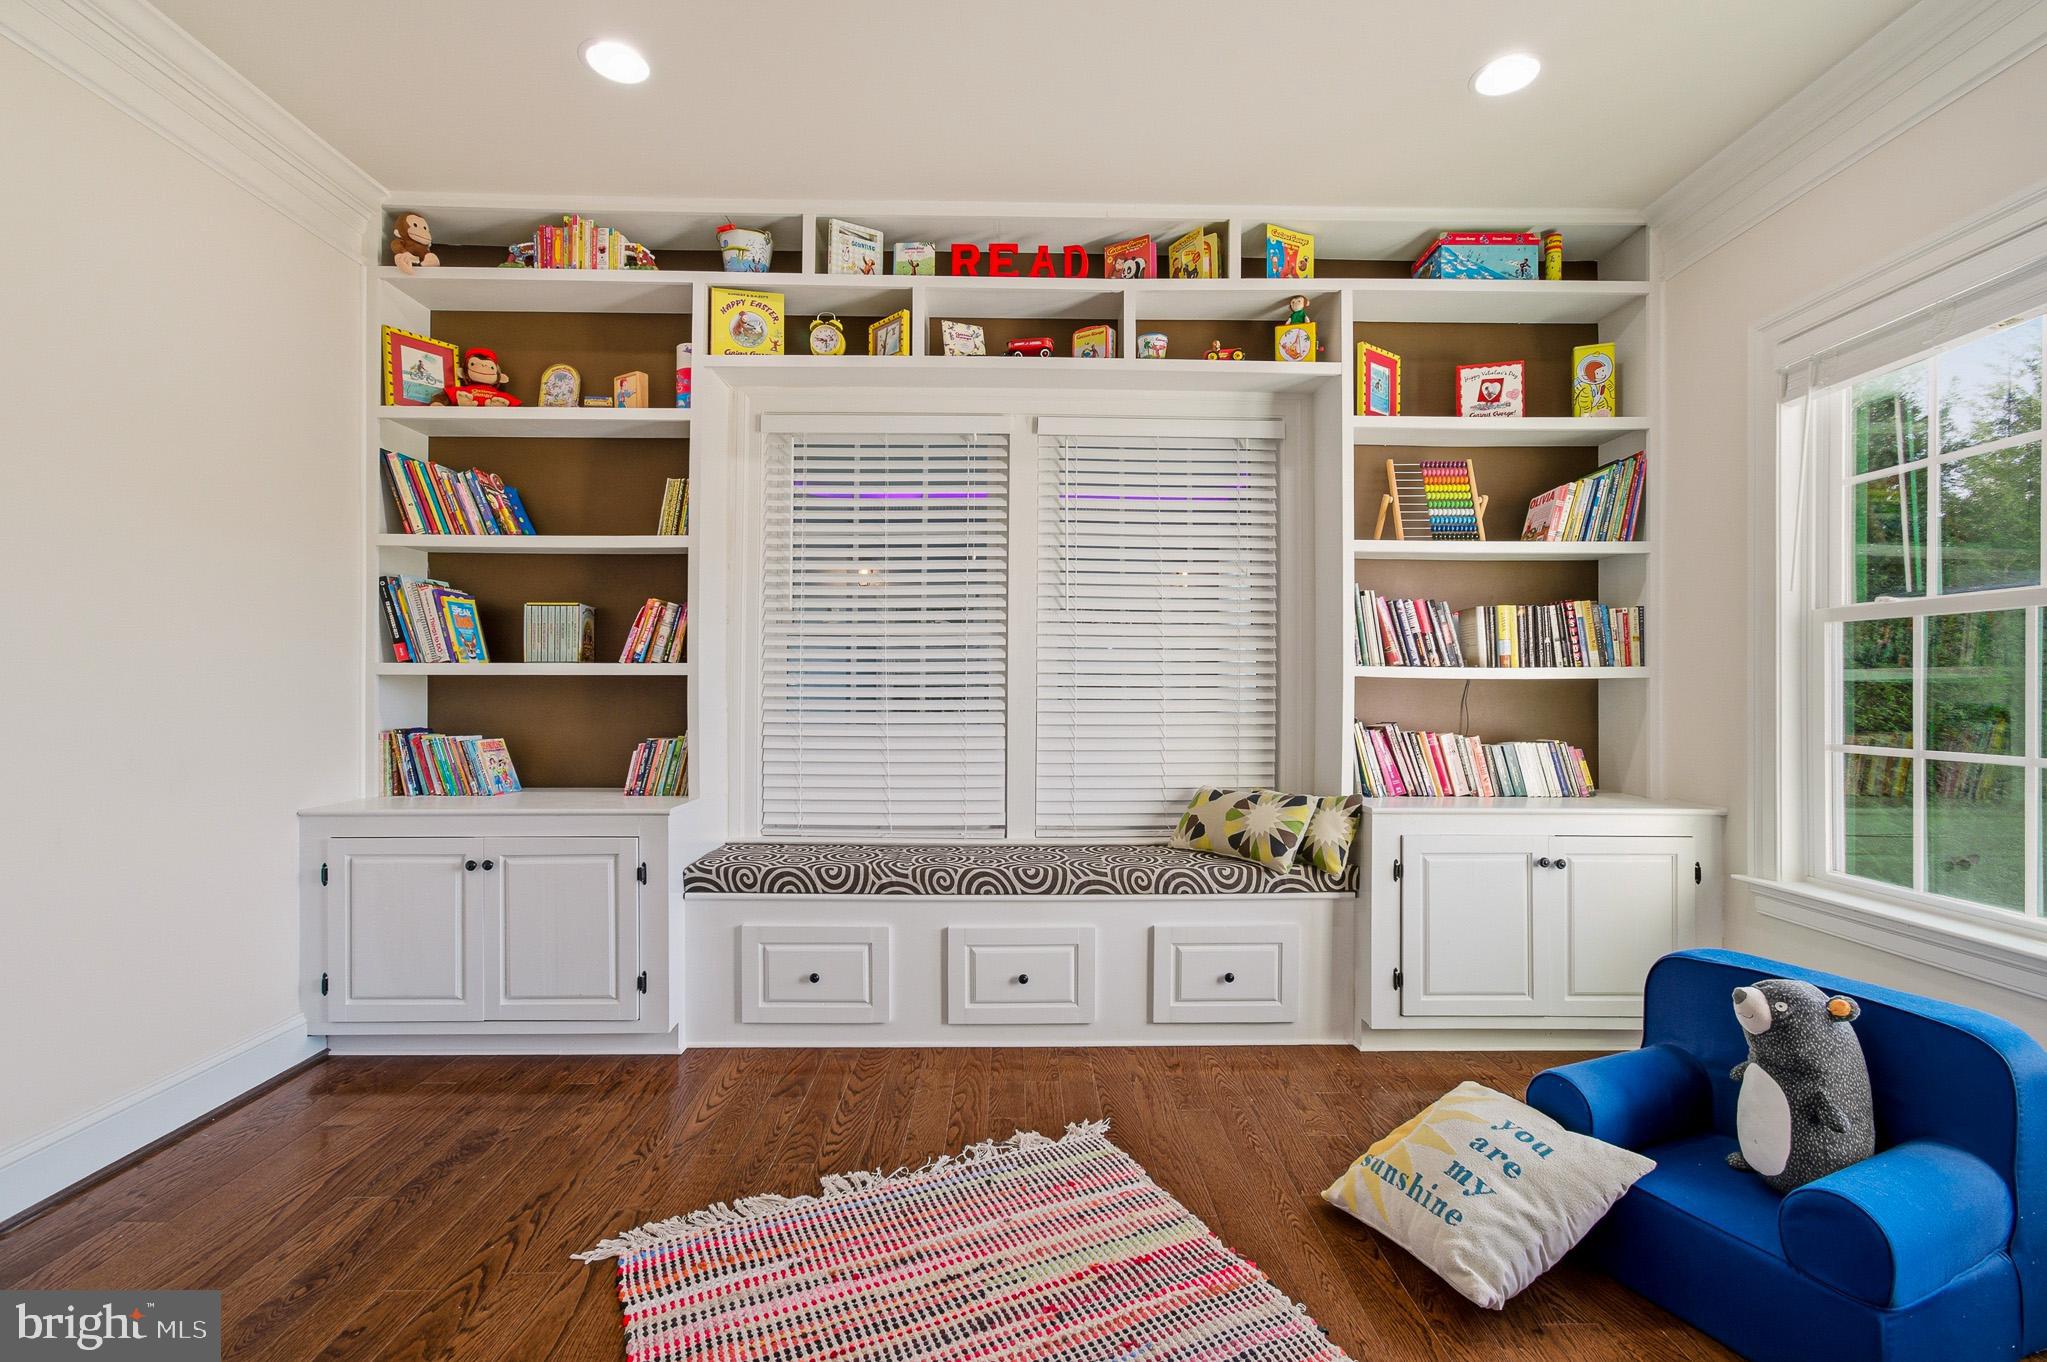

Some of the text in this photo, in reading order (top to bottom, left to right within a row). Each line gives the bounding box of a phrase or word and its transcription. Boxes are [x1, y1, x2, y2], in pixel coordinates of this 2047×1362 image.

[851, 240, 876, 252] COUNTING
[951, 243, 1089, 278] READ
[720, 299, 746, 315] HAPPY
[1529, 490, 1555, 509] OLIVIA
[1469, 1136, 1523, 1180] are
[1491, 1118, 1555, 1161] you
[1360, 1152, 1464, 1228] sunshine
[1444, 1159, 1497, 1198] my
